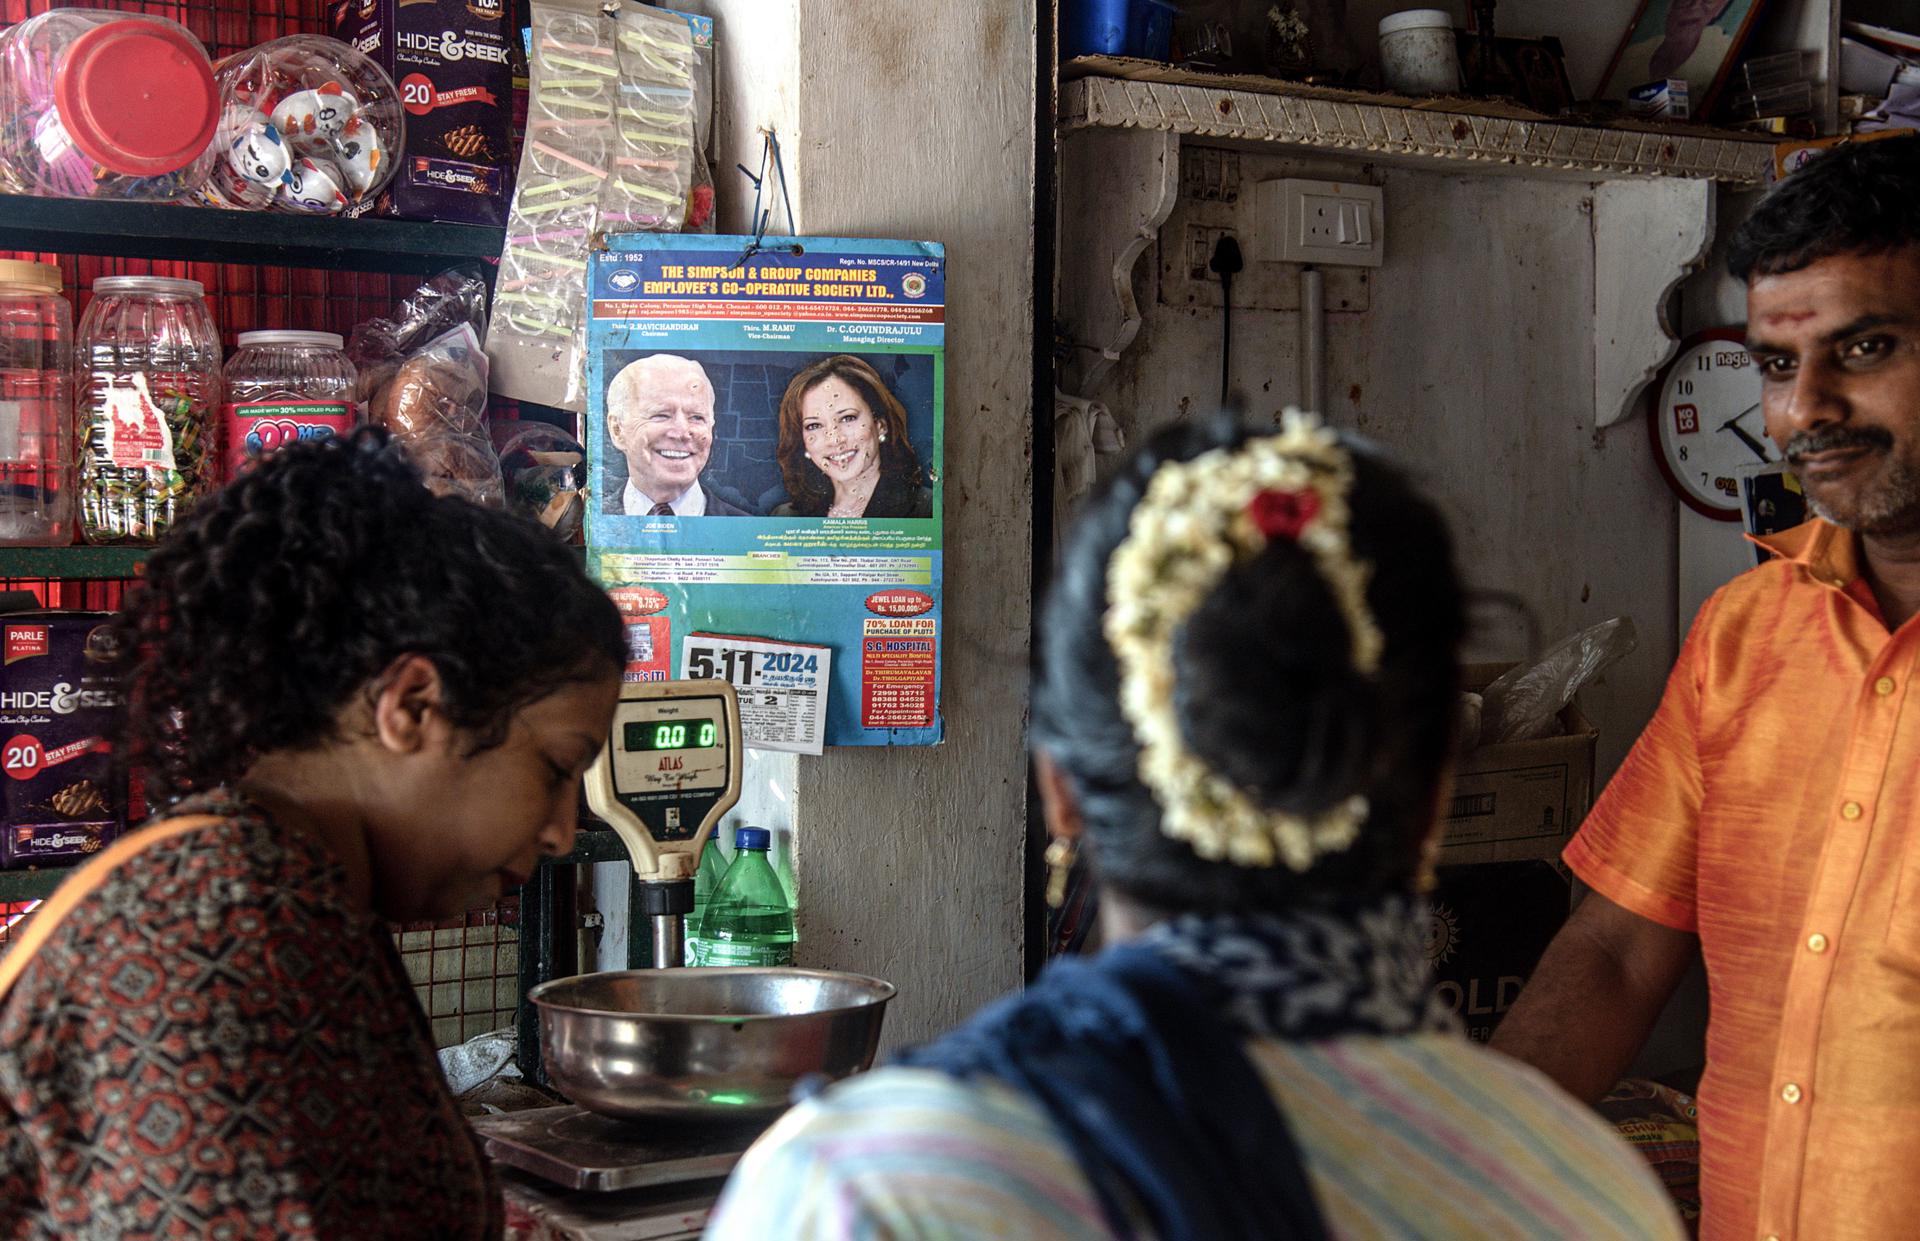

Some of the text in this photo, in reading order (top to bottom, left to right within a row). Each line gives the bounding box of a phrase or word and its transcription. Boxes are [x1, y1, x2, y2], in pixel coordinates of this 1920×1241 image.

[437, 93, 454, 102] STAY
[455, 87, 478, 99] FRESH
[624, 254, 643, 262] 1952
[839, 258, 856, 267] Regn.
[857, 258, 867, 266] No.
[661, 265, 877, 282] THE SIMPSON & GROUP COMPANIES
[643, 281, 718, 295] EMPLOYEE'S
[721, 282, 810, 297] CO-OPERATIVE
[813, 284, 864, 298] SOCIETY
[762, 324, 796, 332] M.RAMU
[826, 325, 922, 335] Dr. C.GOVINDRAJULU
[843, 335, 905, 344] Managing Director
[1697, 355, 1711, 372] 11
[1715, 352, 1750, 369] naga
[1677, 380, 1693, 396] 10
[1679, 445, 1688, 461] 8
[1701, 472, 1709, 487] 7
[871, 596, 891, 604] JEWEL
[907, 597, 914, 605] up
[866, 620, 934, 628] 70% LOAN FOR
[10, 631, 45, 641] PARLE
[886, 642, 931, 651] HOSPITAL
[764, 695, 778, 706] 2
[45, 749, 65, 761] STAY
[658, 756, 684, 772] ATLAS
